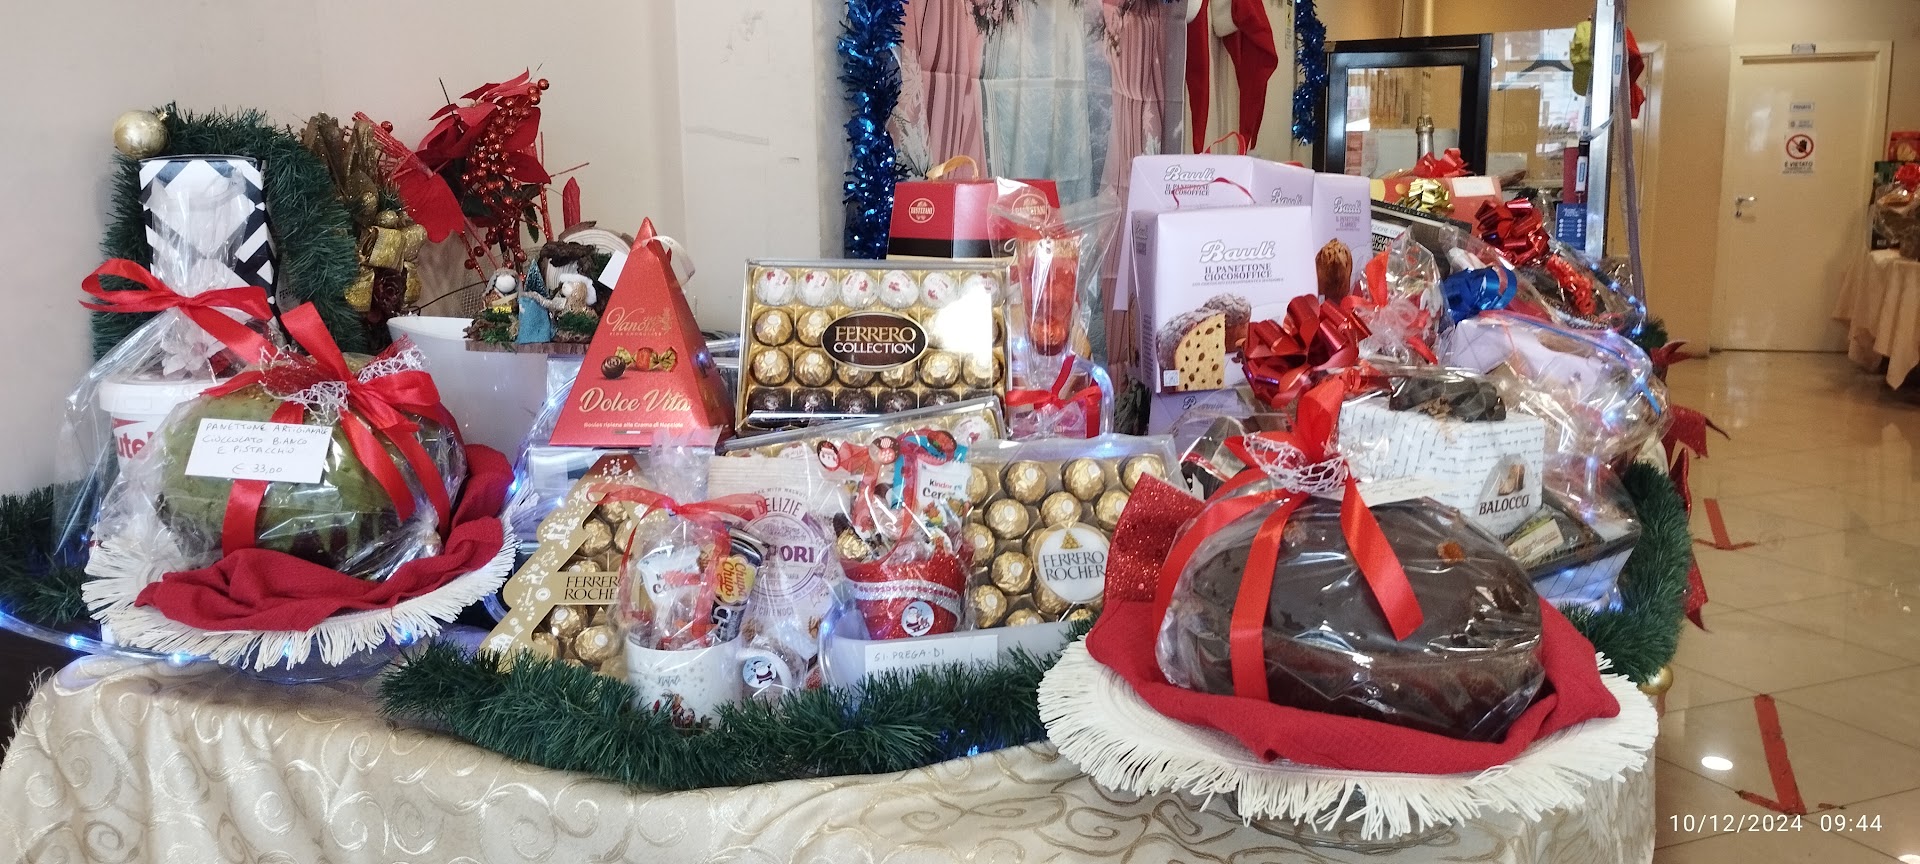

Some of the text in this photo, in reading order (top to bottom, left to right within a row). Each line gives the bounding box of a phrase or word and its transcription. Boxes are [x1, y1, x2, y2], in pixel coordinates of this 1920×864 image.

[1164, 164, 1215, 182] Bauli
[1271, 187, 1303, 206] Bauli
[1333, 196, 1361, 214] Bauli
[1199, 239, 1276, 263] Bauli
[1204, 270, 1272, 281] CIOCOSOFFICE
[1205, 263, 1271, 274] IL PANETTONE
[835, 326, 917, 343] FERRERO
[833, 342, 916, 354] COLLECTION
[579, 387, 692, 413] Dolce Vita
[205, 423, 266, 432] PANETTONE
[1479, 495, 1530, 516] BALOCCO
[1042, 551, 1105, 568] FERRERO
[1045, 565, 1106, 581] ROCHER
